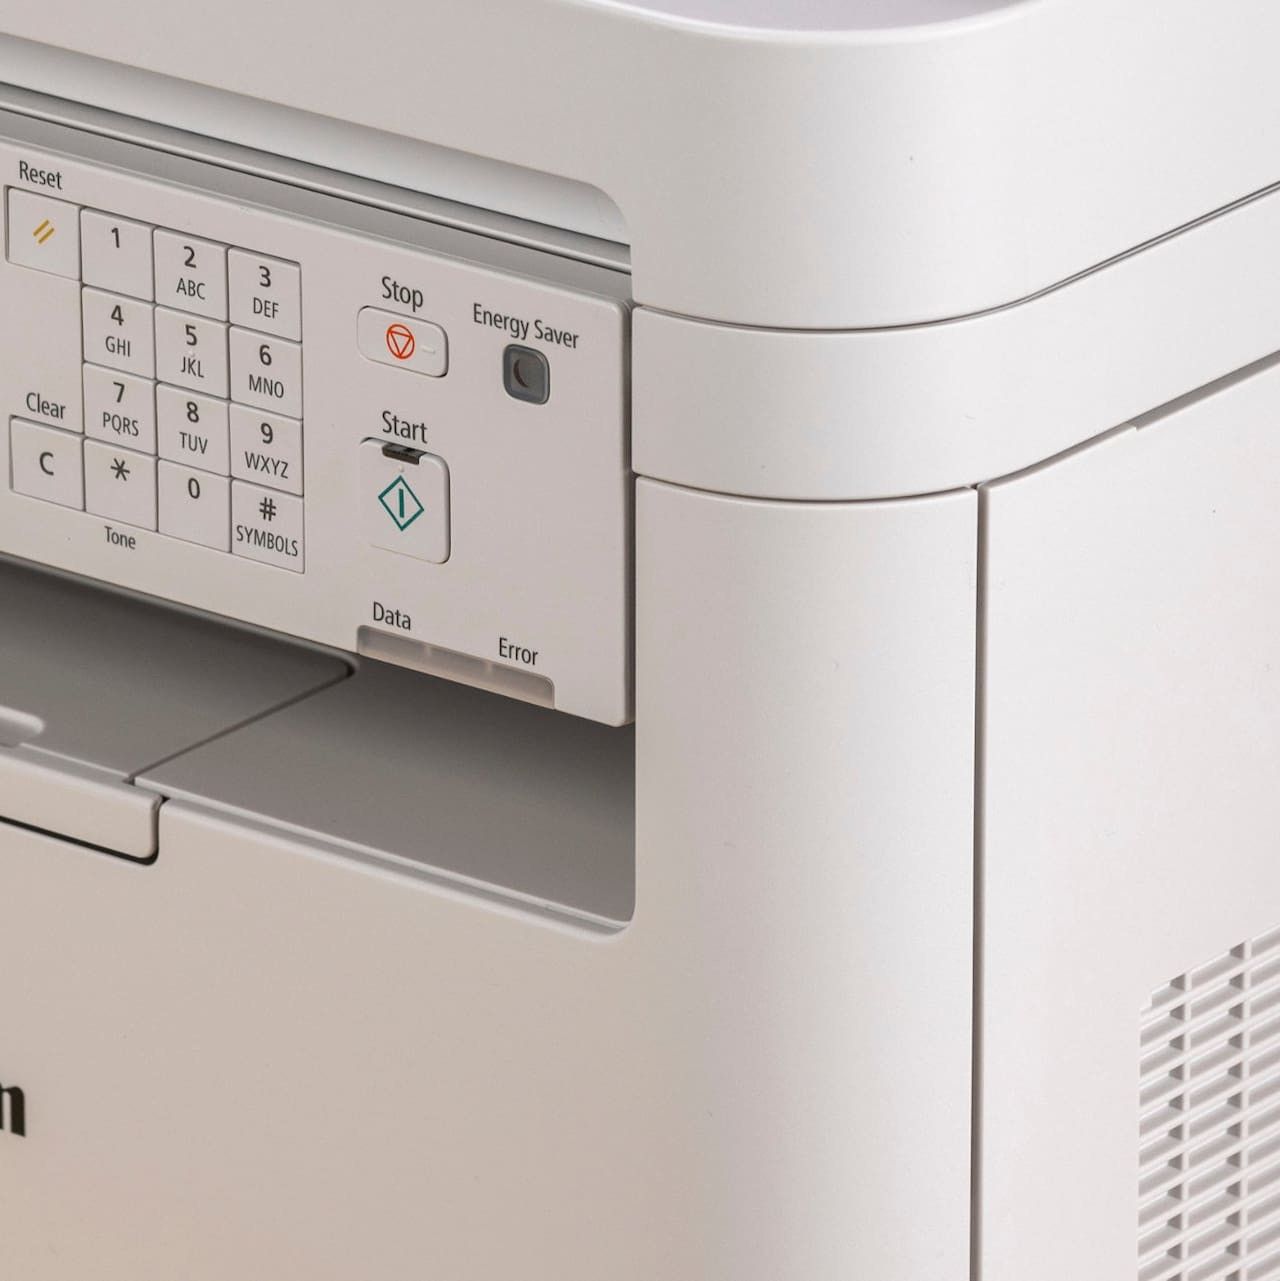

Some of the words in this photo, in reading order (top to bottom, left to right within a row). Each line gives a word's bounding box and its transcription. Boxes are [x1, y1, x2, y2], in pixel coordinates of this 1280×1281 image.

[19, 160, 63, 190] Reset
[111, 227, 121, 249] 1
[183, 245, 197, 269] 2
[175, 277, 206, 300] ABC
[258, 265, 272, 288] 3
[381, 275, 424, 308] Stop
[110, 304, 125, 327] 4
[252, 296, 279, 319] DEF
[184, 323, 198, 347] 5
[473, 303, 530, 340] Energy
[534, 320, 580, 350] Saver
[105, 335, 131, 358] GHI
[258, 343, 273, 367] 6
[180, 356, 205, 379] JKL
[112, 381, 126, 404] 7
[248, 373, 285, 399] MNO
[26, 391, 66, 419] Clear
[186, 400, 200, 424] 8
[102, 411, 140, 437] PQRS
[260, 422, 274, 445] 9
[381, 410, 428, 443] Start
[179, 431, 209, 455] TUV
[39, 451, 55, 477] C
[245, 451, 289, 479] WXYZ
[187, 477, 201, 500] 0
[104, 525, 137, 550] Tone
[236, 524, 298, 558] SYMBOLS
[372, 601, 411, 630] Data
[498, 636, 539, 666] Error
